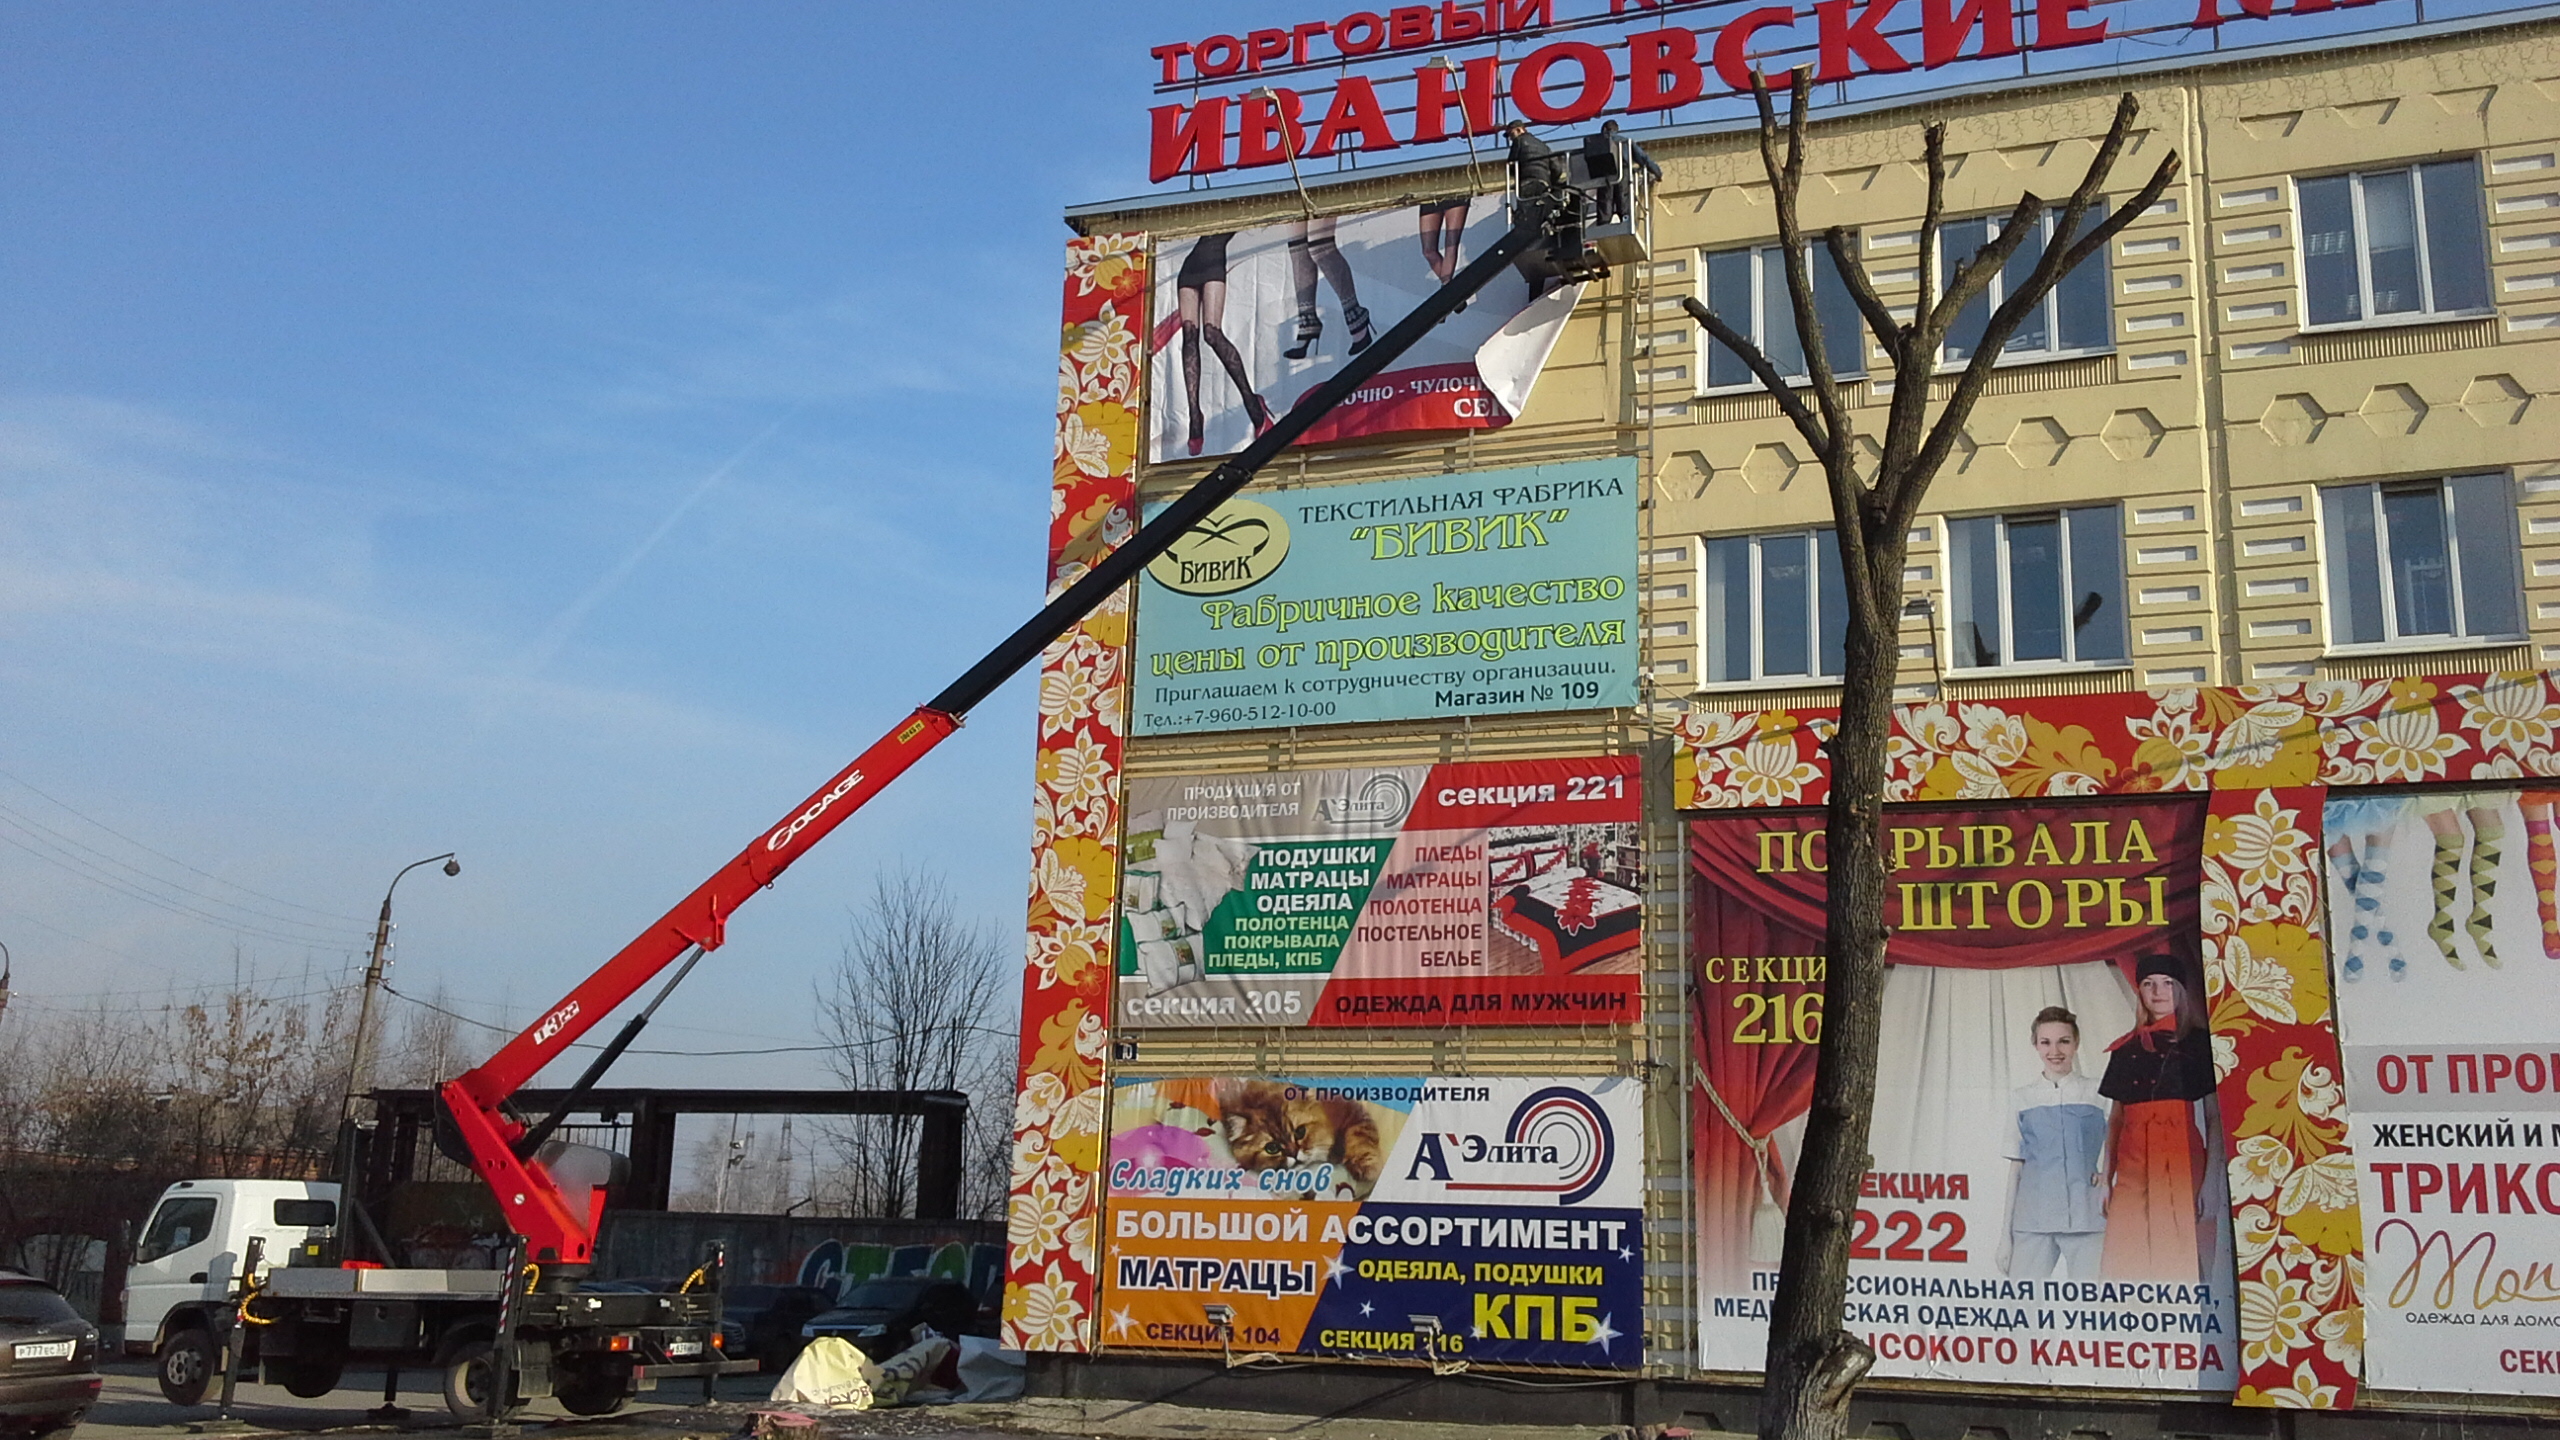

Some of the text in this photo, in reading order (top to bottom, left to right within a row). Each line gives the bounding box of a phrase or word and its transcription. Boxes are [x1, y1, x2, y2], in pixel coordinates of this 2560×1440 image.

[1151, 0, 1553, 83] ТОРГОВЫЙ
[1149, 0, 2109, 183] ИВАНОВСКИЕ
[1299, 477, 1624, 524] ТЕКСТИЛЬНАЯ ФАБРИКА
[1179, 554, 1254, 585] БИВИК
[1201, 575, 1626, 633] Фабричное качество
[1150, 618, 1626, 679] цены от производителя
[1155, 661, 1617, 703] Приглашаем к сотрудничеству организации.
[1434, 681, 1600, 710] Магазин № 109
[1184, 782, 1300, 801] ПРОДУКЦИЯ ОТ
[1437, 775, 1624, 807] секция 221
[1166, 802, 1299, 821] ПРОИЗВОДИТЕЛЯ
[1258, 846, 1377, 868] ПОДУШКИ
[1415, 845, 1483, 864] ПЛЕДЫ
[1756, 819, 2159, 873] ПОРЫВАЛА
[1250, 869, 1370, 891] МАТРАЦЫ
[1386, 872, 1483, 892] МАТРАЦЫ
[1256, 893, 1354, 914] ОДЕЯЛА
[1369, 898, 1483, 918] ПОЛОТЕНЦА
[1897, 876, 2170, 931] ШТОРЫ
[1235, 916, 1350, 933] ПОЛОТЕНЦА
[1357, 924, 1483, 943] ПОСТЕЛЬНОЕ
[1224, 935, 1341, 951] ПОКРЫВАЛА
[1208, 952, 1323, 970] ПЛЕДЫ, КПБ
[1420, 951, 1483, 969] БЕЛЬЕ
[1705, 956, 1827, 986] СЕКЦИ
[1126, 990, 1302, 1018] секция 205
[1335, 991, 1627, 1016] ОДЕЖДА ДЛЯ МУЖЧИН
[1732, 992, 1825, 1044] 216
[2376, 1054, 2434, 1094] ОТ
[1284, 1087, 1489, 1104] ОТ ПРОИЗВОДИТЕЛЯ
[2373, 1118, 2515, 1148] ЖЕНСКИЙ
[2524, 1124, 2543, 1147] И
[1111, 1159, 1333, 1195] Сладких снов
[1859, 1172, 1970, 1202] ЕКЦИЯ
[1115, 1207, 1627, 1251] БОЛЬШОЙ АССОРТИМЕНТ
[1850, 1209, 1968, 1263] 222
[1117, 1256, 1316, 1300] МАТРАЦЫ
[1358, 1259, 1603, 1285] ОДЕЯЛА, ПОДУШКИ
[2043, 1282, 2221, 1310] ПОВАРСКАЯ,
[1473, 1293, 1600, 1342] КПБ
[1918, 1304, 2024, 1331] ОДЕЖДА
[2038, 1310, 2055, 1330] И
[2065, 1312, 2222, 1335] УНИФОРМА
[2405, 1311, 2475, 1326] одежда
[2480, 1314, 2509, 1326] для
[1146, 1323, 1281, 1344] СЕКЦИЯ 104
[1320, 1329, 1464, 1353] СЕКЦИЯ 16
[1868, 1332, 2224, 1372] СОКОГО КАЧЕСТВА
